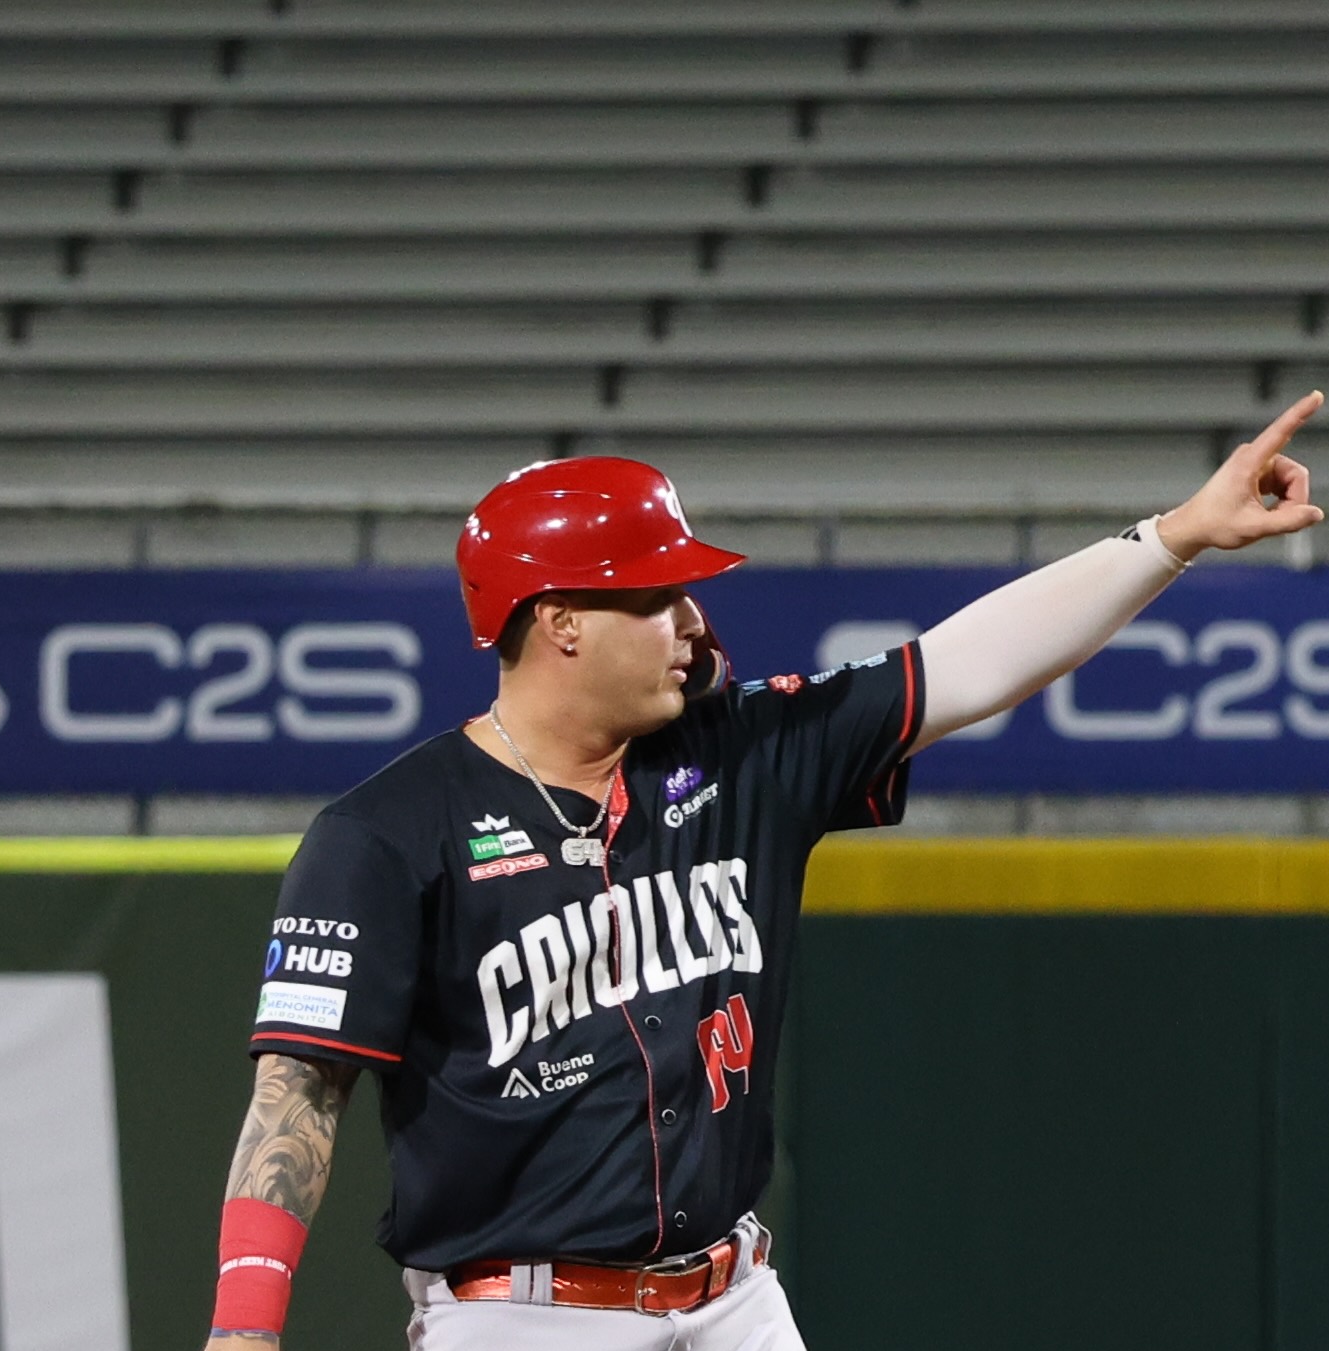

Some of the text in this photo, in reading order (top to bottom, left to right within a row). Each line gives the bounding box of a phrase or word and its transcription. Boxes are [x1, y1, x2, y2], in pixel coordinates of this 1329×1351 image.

[38, 622, 423, 743] C2S
[472, 855, 545, 878] ECONO
[272, 916, 360, 940] VOLVO
[284, 944, 353, 978] HUB
[476, 857, 763, 1068] CRIOLLOS
[537, 1052, 595, 1078] Buena
[540, 1070, 590, 1094] Coop
